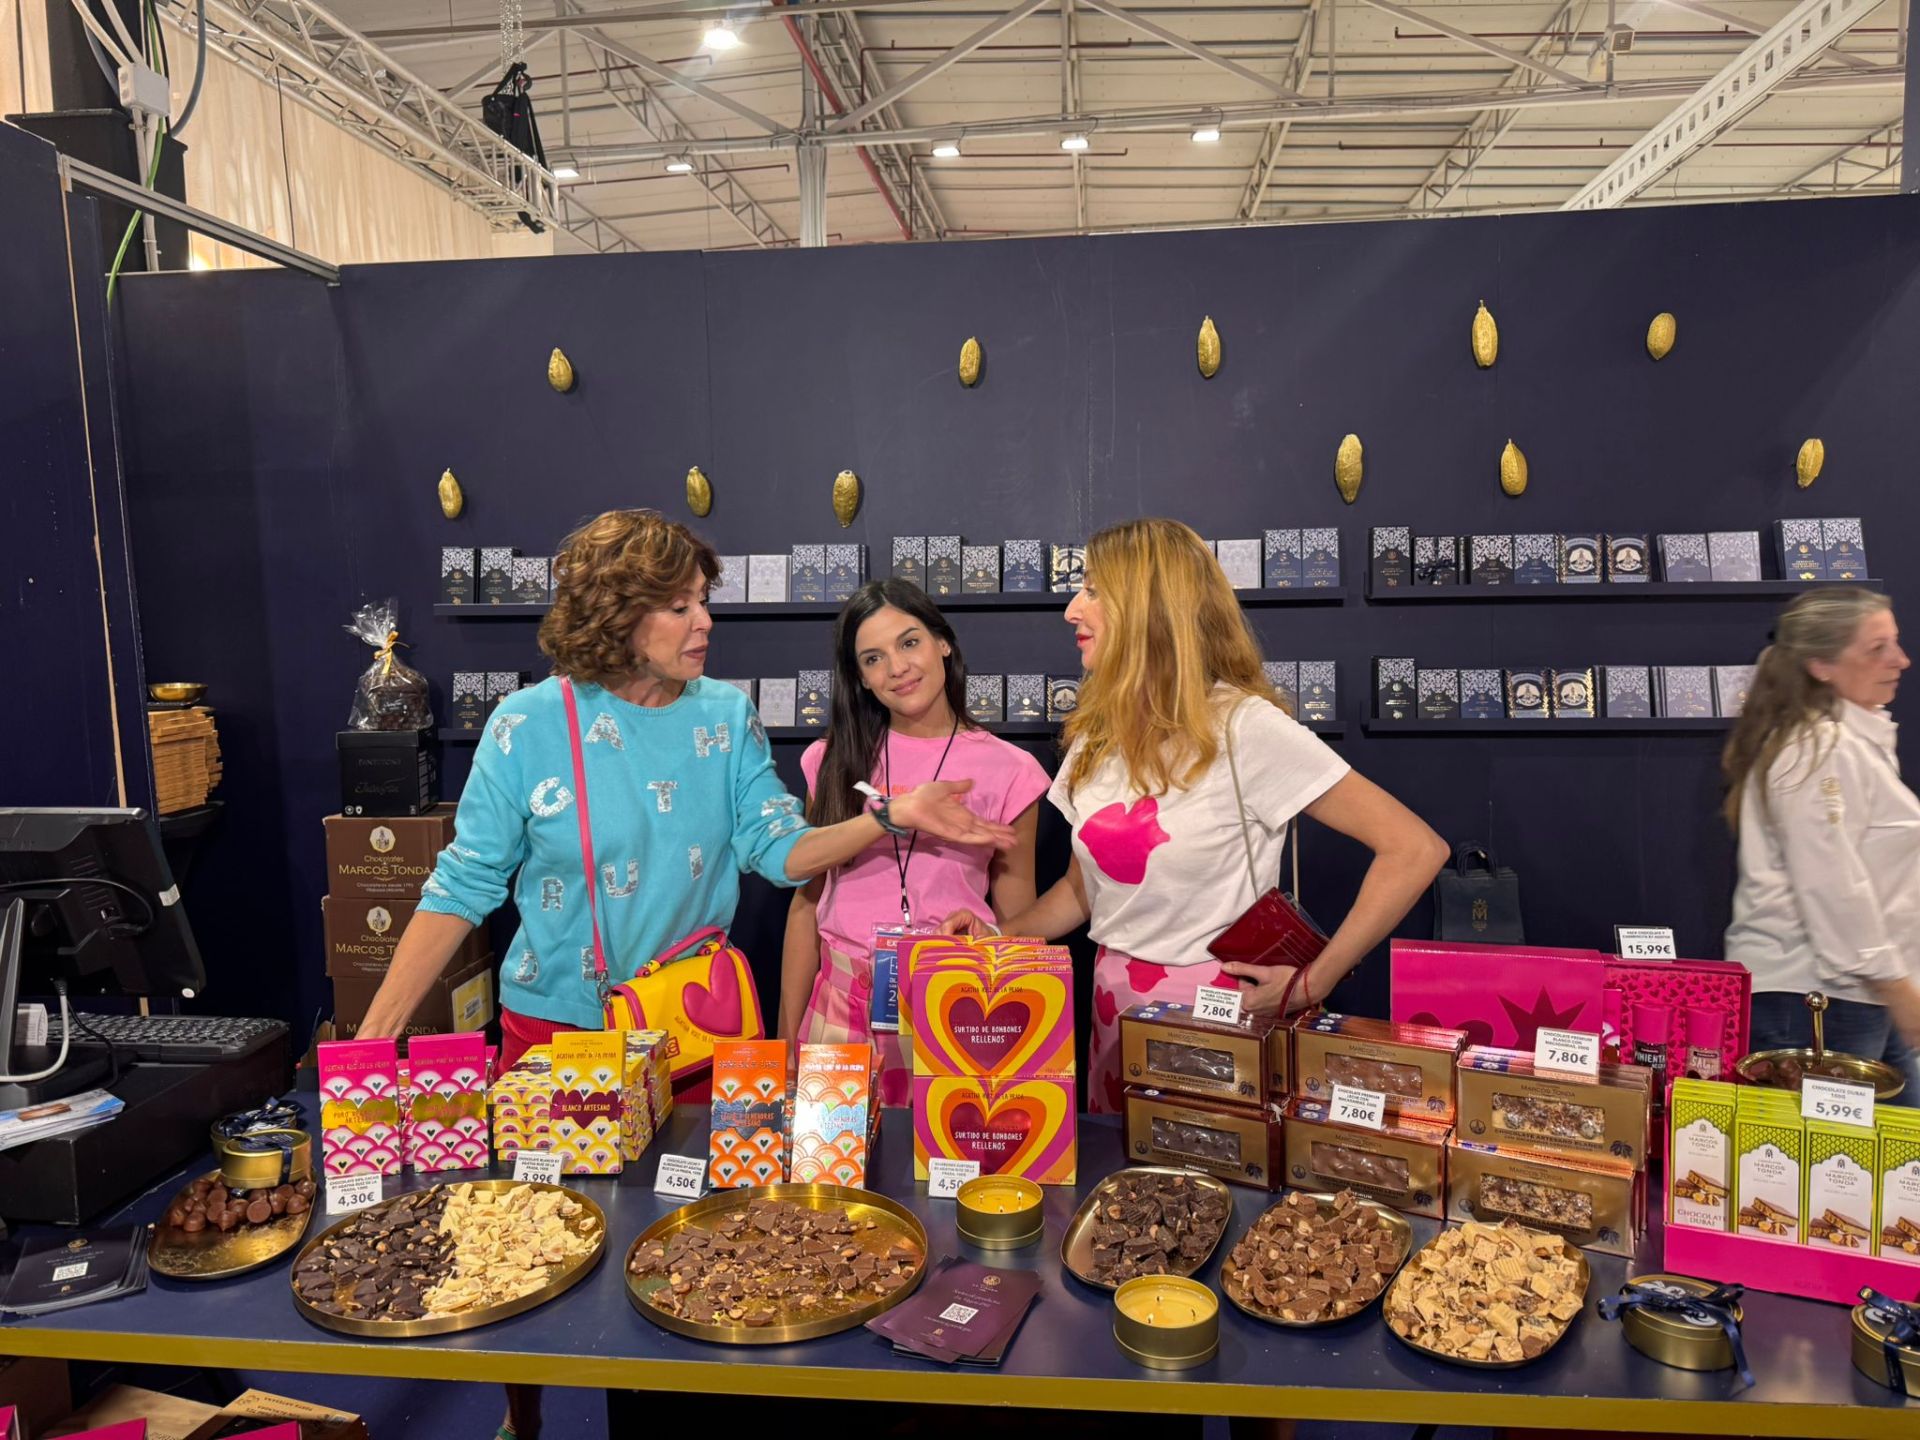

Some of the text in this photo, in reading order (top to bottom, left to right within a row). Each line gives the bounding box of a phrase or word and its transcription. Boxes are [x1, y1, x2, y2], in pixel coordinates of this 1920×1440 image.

[583, 711, 625, 751] A
[692, 721, 732, 758] H
[529, 776, 575, 817] G
[646, 780, 678, 814] T
[364, 855, 404, 863] Chocolates
[338, 864, 431, 876] MARCOS TONDA
[601, 858, 640, 898] U
[540, 876, 566, 911] R
[335, 943, 385, 955] MARCOS
[1628, 944, 1671, 955] 15,99€
[1202, 1004, 1233, 1018] 7,80€
[404, 1025, 438, 1035] ONDA
[954, 1025, 980, 1034] SURTIDO
[982, 1025, 990, 1033] DE
[1543, 1031, 1570, 1039] CHOCOLATE
[970, 1035, 1005, 1044] RELLENOS
[1548, 1049, 1589, 1065] 7,80€
[1521, 1084, 1575, 1097] MARCOS TONDA
[1811, 1084, 1846, 1094] CHOCOLATE
[562, 1104, 611, 1112] BLANCO ARTESANO
[1340, 1105, 1376, 1122] 7,80€
[1815, 1102, 1863, 1119] 5,99€
[955, 1131, 981, 1139] SURTIDO
[1494, 1129, 1603, 1150] CHOCOLATE ARTESANO BLANCO
[1689, 1136, 1719, 1145] MARCOS
[971, 1141, 1006, 1150] RELLENOS
[1185, 1164, 1208, 1173] PREMIUM
[1754, 1162, 1787, 1171] MARCOS
[666, 1175, 697, 1189] 4,50€
[1825, 1173, 1858, 1182] MARCOS
[1828, 1178, 1855, 1186] TONDA
[938, 1178, 964, 1190] 4,50
[1899, 1180, 1920, 1189] MARC
[1902, 1185, 1920, 1193] TON
[338, 1191, 375, 1207] 4,30€
[1677, 1208, 1727, 1223] CHOCOLATE
[1689, 1217, 1715, 1226] DUBAI
